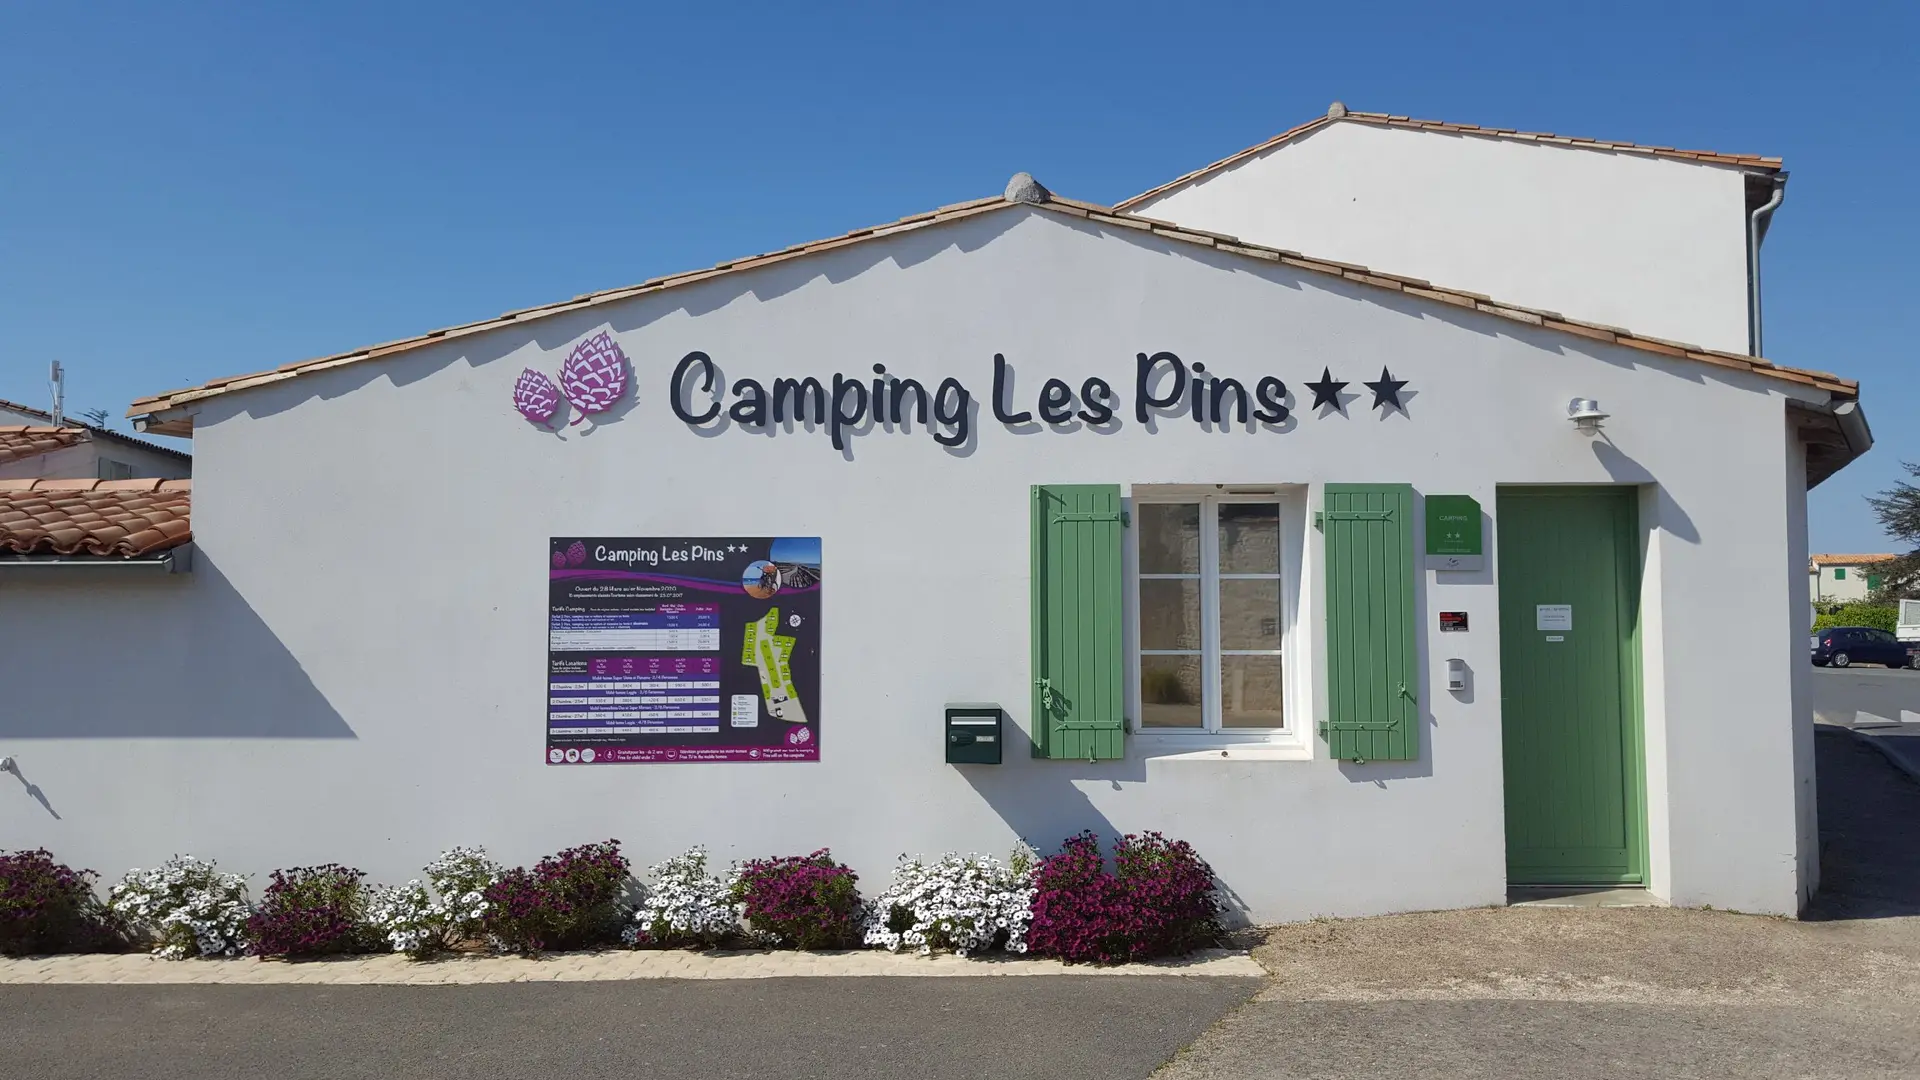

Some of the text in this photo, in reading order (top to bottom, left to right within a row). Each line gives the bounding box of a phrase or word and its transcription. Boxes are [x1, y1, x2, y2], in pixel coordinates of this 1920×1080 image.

[670, 351, 1290, 451] Camping Les Pins
[595, 545, 724, 567] Camping Les Pins
